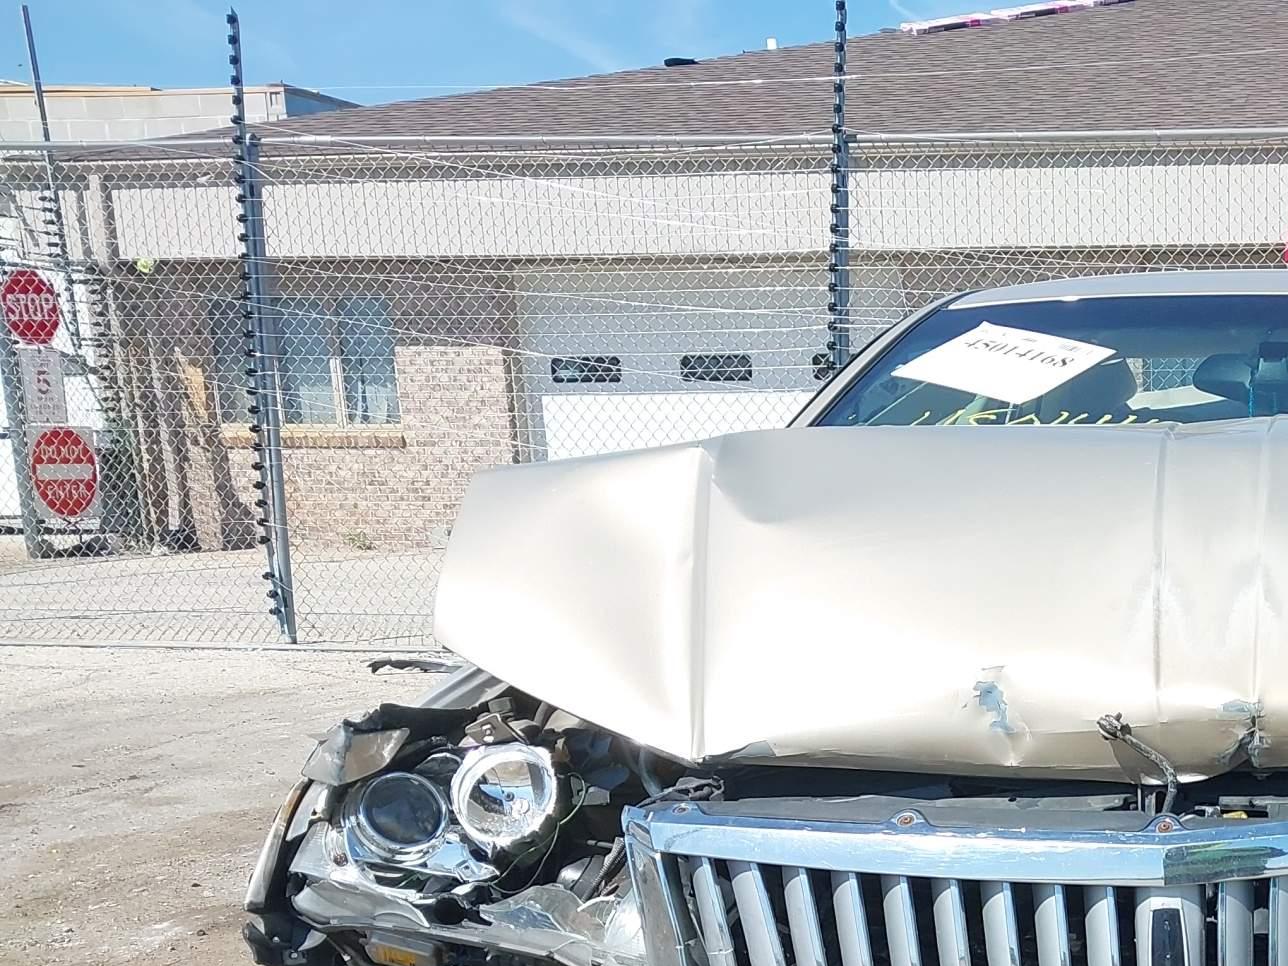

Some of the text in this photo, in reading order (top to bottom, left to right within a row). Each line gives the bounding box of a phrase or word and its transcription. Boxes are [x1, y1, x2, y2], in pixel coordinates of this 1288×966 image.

[6, 293, 54, 320] STOP
[964, 339, 1075, 368] 45014168
[36, 369, 52, 395] 5
[40, 445, 57, 459] DO
[47, 484, 88, 500] ENTER
